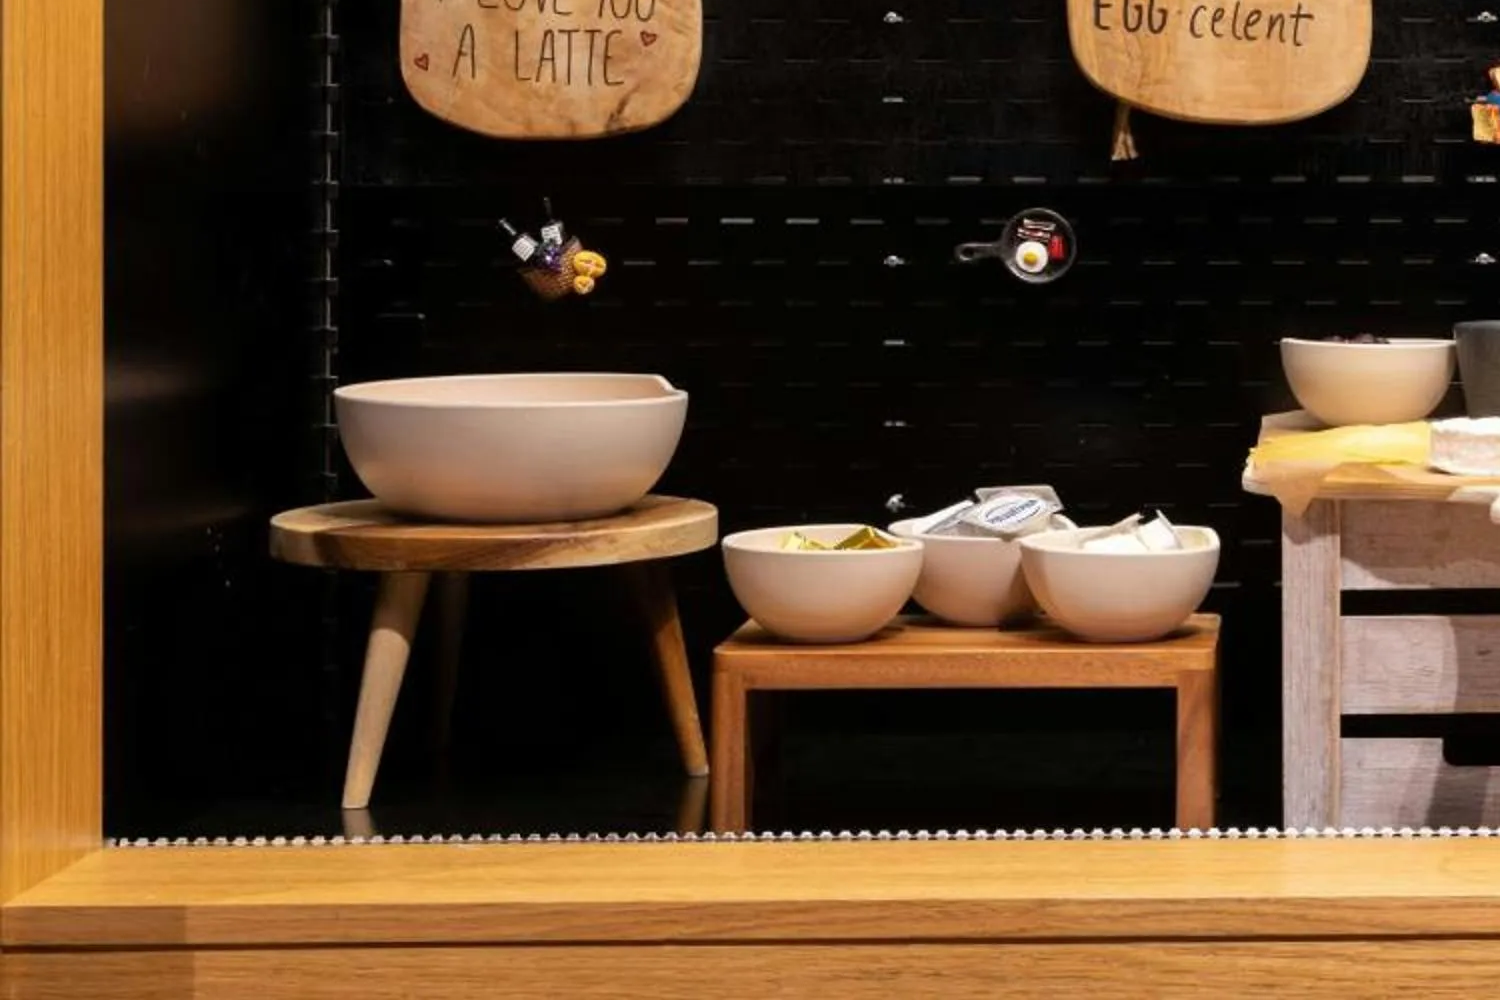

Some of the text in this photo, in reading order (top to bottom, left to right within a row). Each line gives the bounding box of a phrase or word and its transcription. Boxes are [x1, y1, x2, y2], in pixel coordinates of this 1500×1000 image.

[1189, 1, 1316, 47] celent
[452, 23, 625, 86] A LATTE
